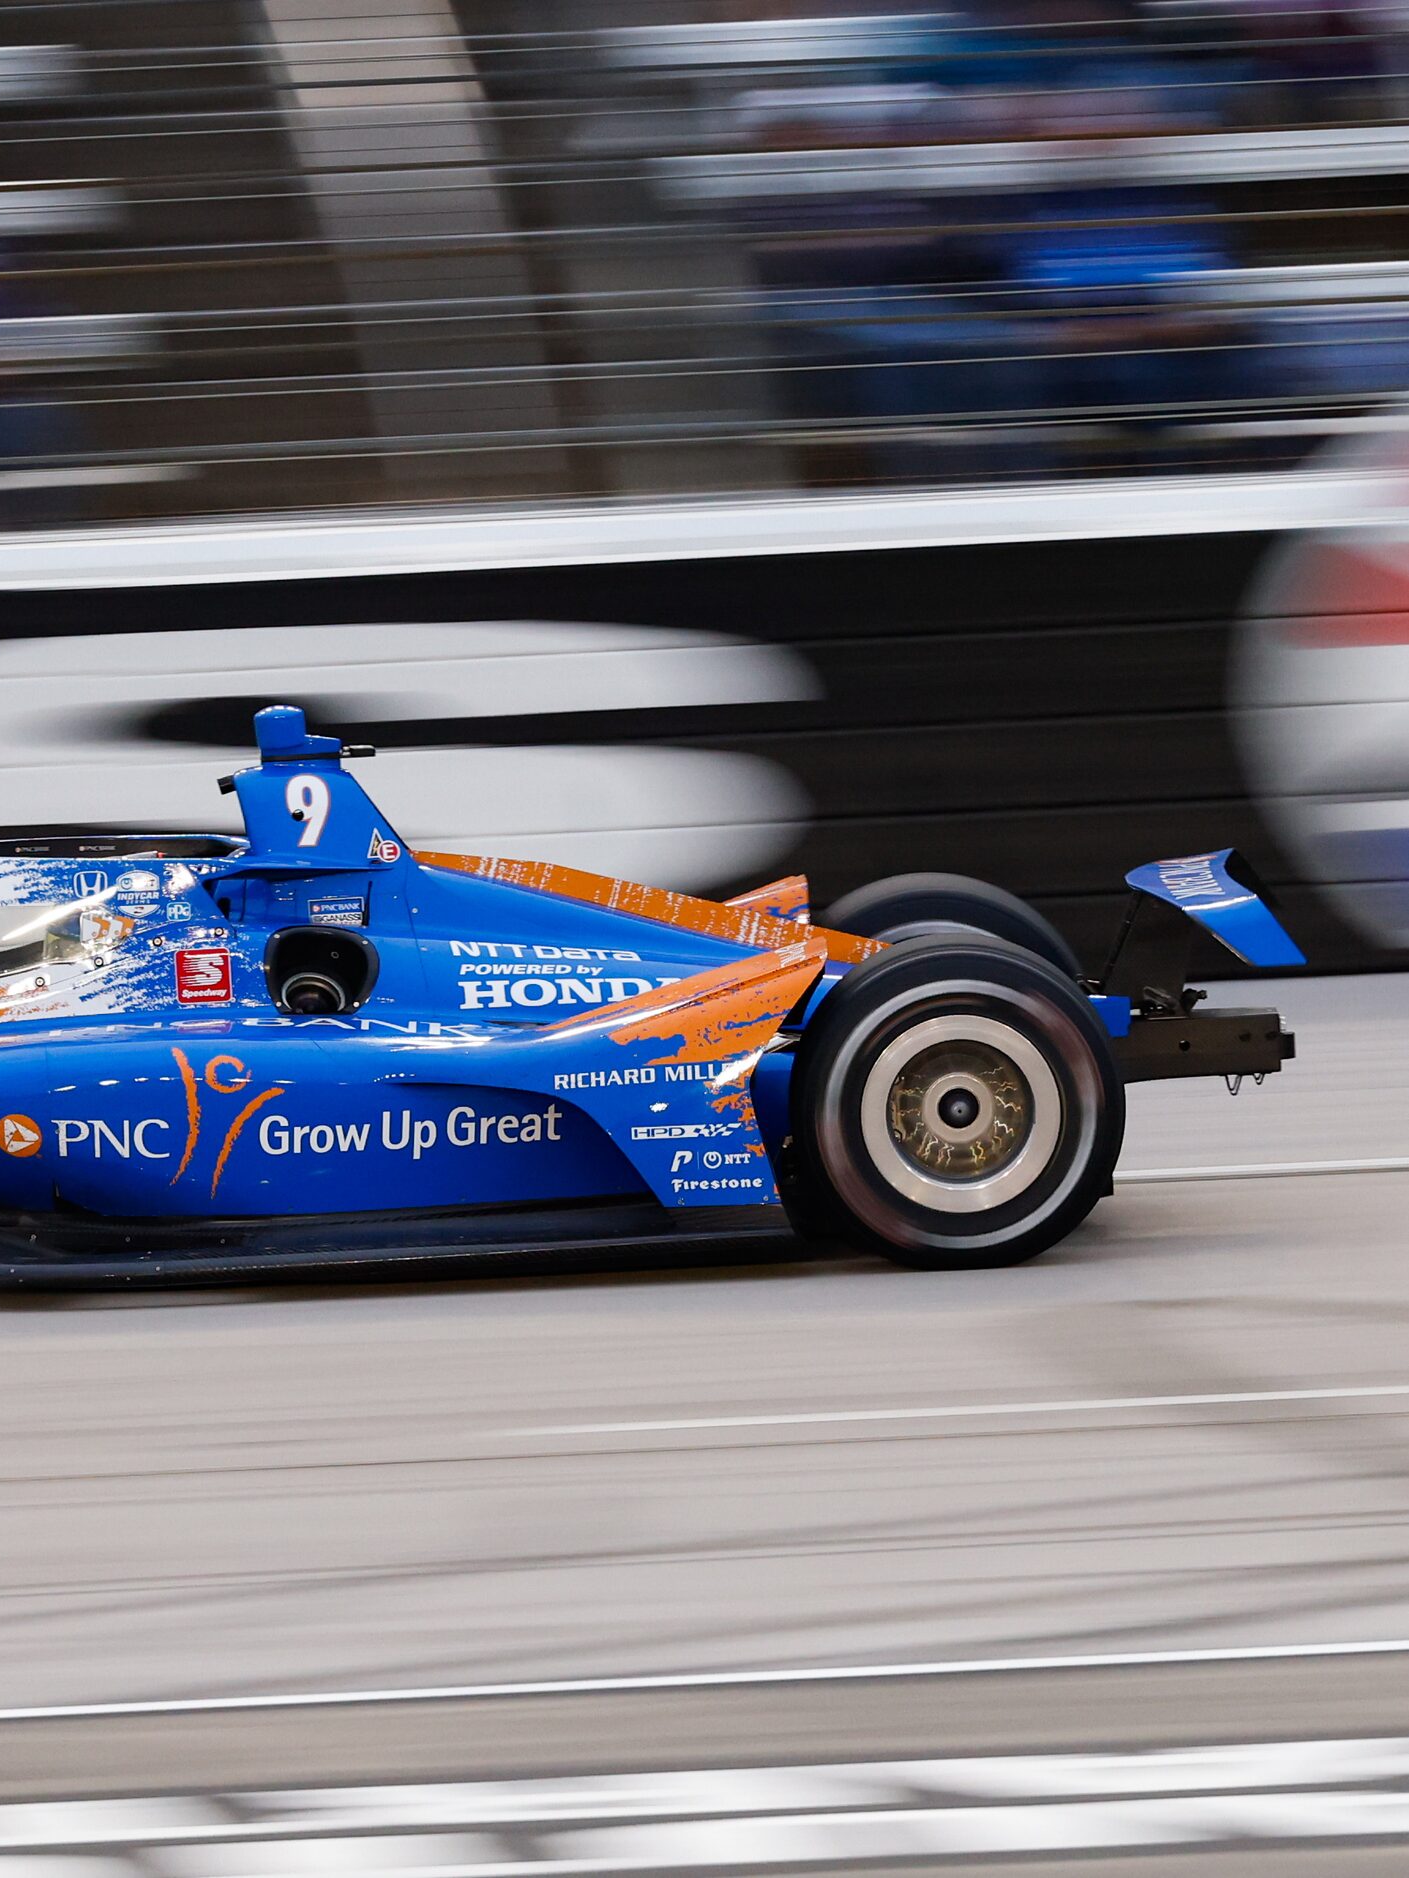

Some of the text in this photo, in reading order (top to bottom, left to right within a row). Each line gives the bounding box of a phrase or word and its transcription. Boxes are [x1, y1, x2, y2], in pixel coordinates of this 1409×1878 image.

[286, 774, 330, 847] 9
[117, 891, 159, 900] INDYCAR
[449, 941, 527, 958] NTT
[459, 963, 604, 977] POWERED by
[182, 988, 227, 999] Speedway
[554, 1064, 655, 1090] RICHARD
[50, 1103, 563, 1160] PNC Grow Up Great
[633, 1126, 686, 1138] HPD
[724, 1153, 751, 1165] NTT
[671, 1178, 763, 1193] Firestone
